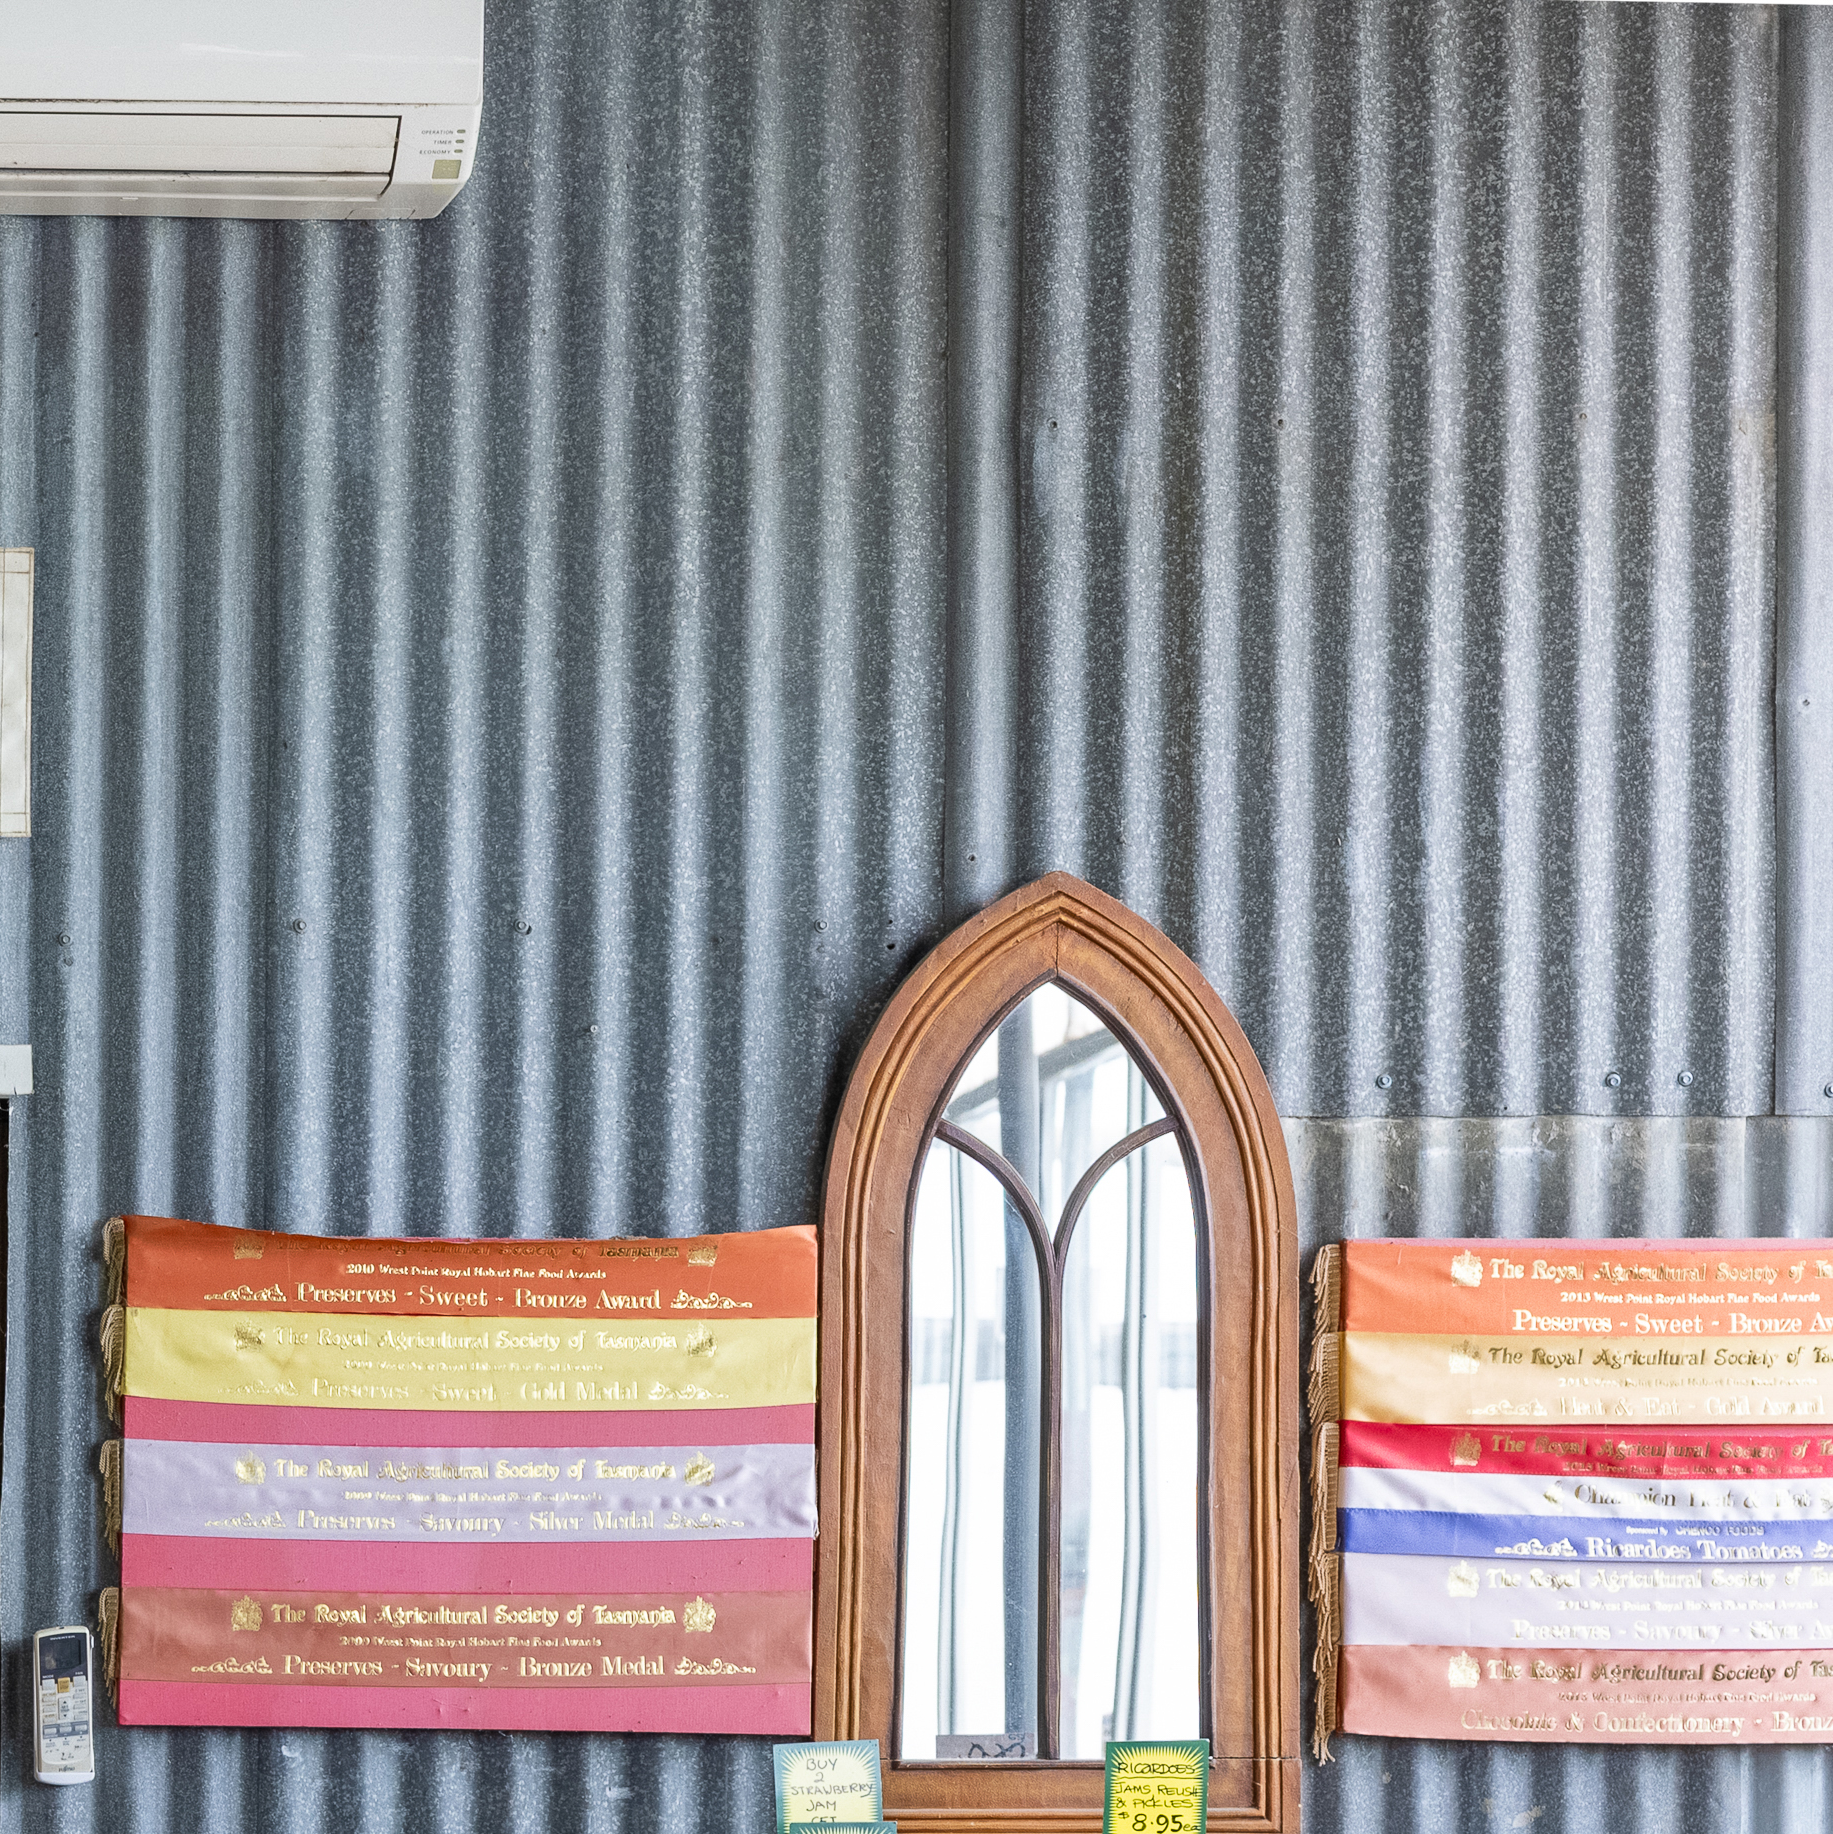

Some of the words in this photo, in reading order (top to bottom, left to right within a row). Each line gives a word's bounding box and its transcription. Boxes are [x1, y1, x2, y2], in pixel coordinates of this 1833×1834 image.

[295, 1282, 396, 1303] Preserves
[419, 1285, 488, 1307] Sweet
[512, 1288, 587, 1309] Bronze
[594, 1289, 662, 1310] Award
[1594, 1292, 1623, 1304] Wrest
[1625, 1293, 1653, 1304] Point
[1655, 1293, 1686, 1305] Royal
[1688, 1293, 1724, 1304] Hobart
[1727, 1292, 1750, 1304] Fine
[1752, 1292, 1777, 1303] Food
[1780, 1292, 1820, 1303] Awards
[1512, 1308, 1613, 1332] Preserves
[1635, 1312, 1703, 1334] Sweet
[1727, 1312, 1802, 1334] Bronze
[1585, 1536, 1692, 1560] Ricardoes
[1696, 1540, 1803, 1561] Tomatoes
[271, 1603, 307, 1623] The
[314, 1603, 367, 1627] Royal
[374, 1604, 488, 1628] Agricultural
[494, 1604, 559, 1627] Society
[566, 1603, 586, 1627] of
[592, 1604, 676, 1628] Tasmania
[281, 1654, 383, 1676] Preserves
[405, 1656, 492, 1683] Savoury
[518, 1655, 592, 1677] Bronze
[600, 1655, 665, 1676] Medal
[806, 1758, 838, 1771] BUY
[814, 1771, 825, 1783] 2
[791, 1782, 875, 1798] STRAWBERRY
[1115, 1781, 1152, 1794] JAMS
[805, 1800, 837, 1812] JAM
[1133, 1795, 1194, 1808] PICKLES
